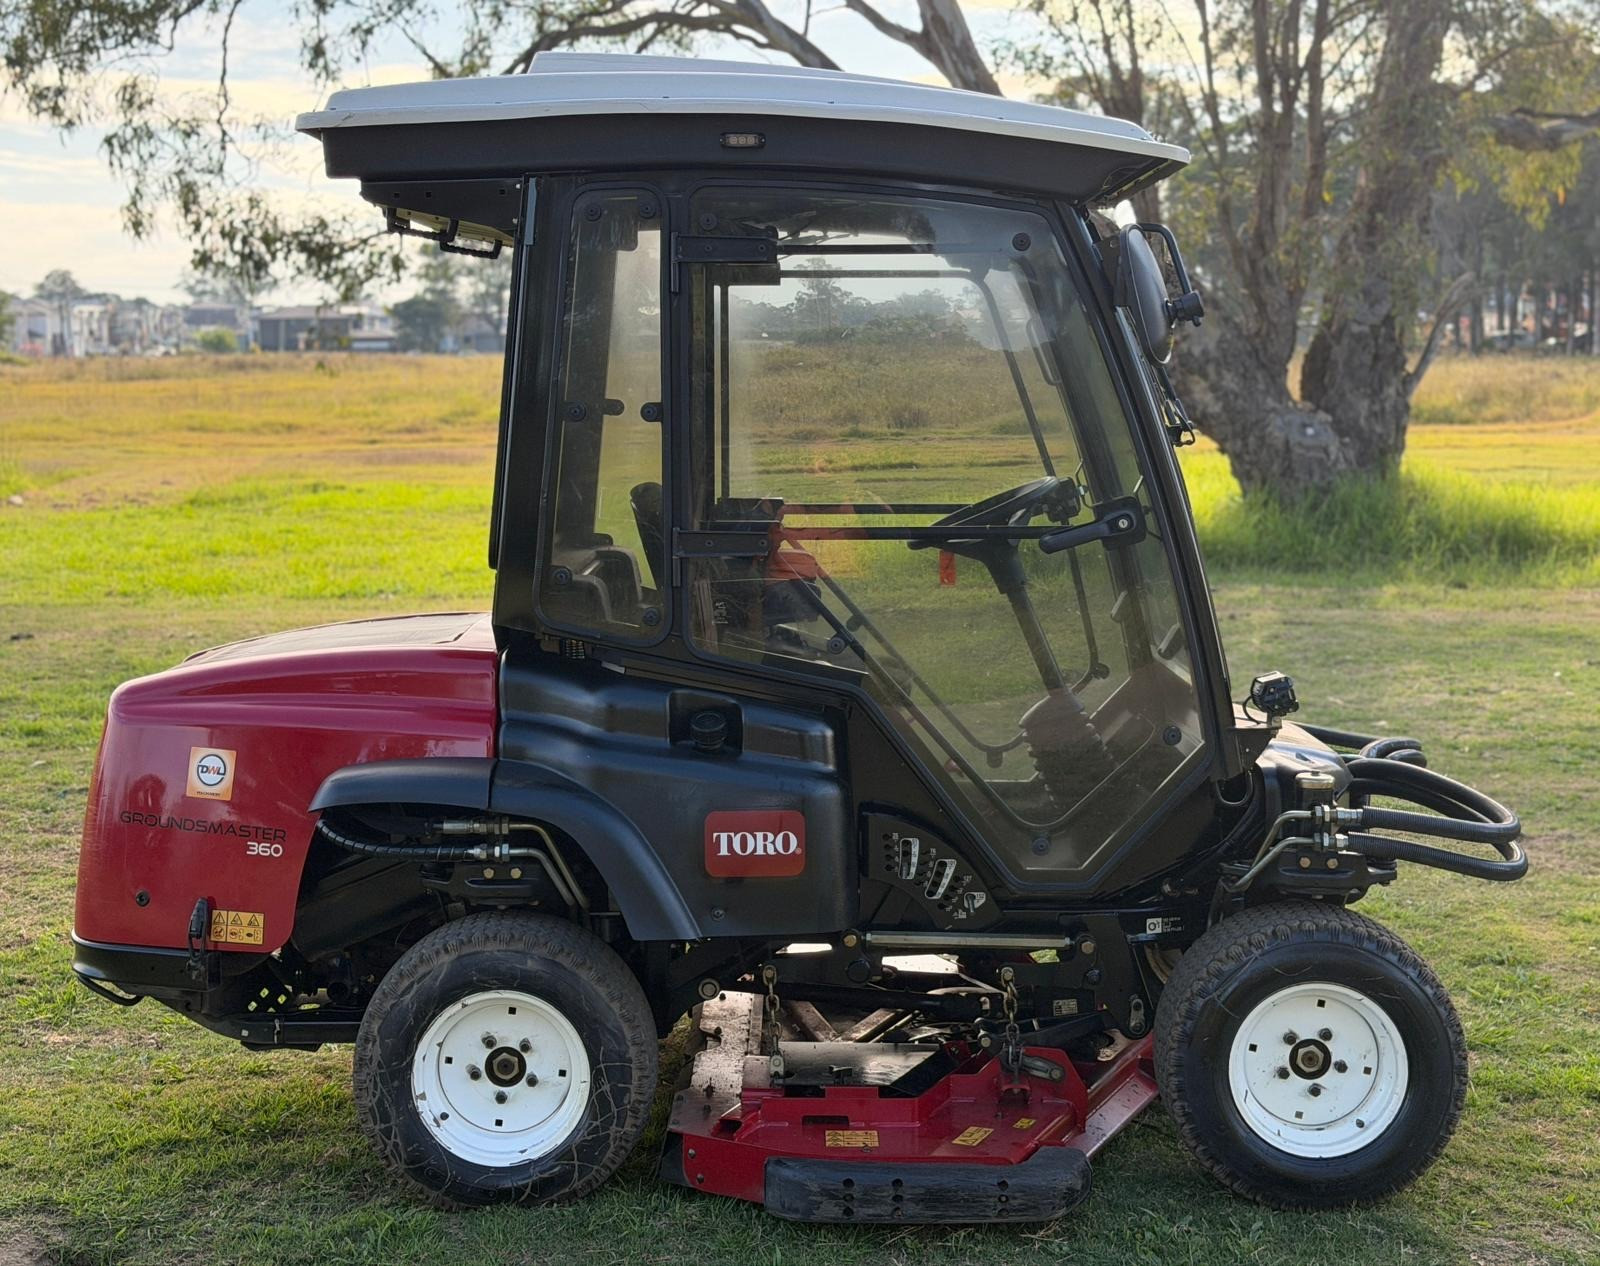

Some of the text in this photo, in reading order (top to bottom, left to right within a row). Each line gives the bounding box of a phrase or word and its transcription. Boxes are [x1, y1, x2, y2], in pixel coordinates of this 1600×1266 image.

[197, 764, 226, 776] DWL
[120, 810, 287, 842] GROUNDSMASTER
[246, 841, 284, 858] 360
[712, 830, 798, 856] TORO
